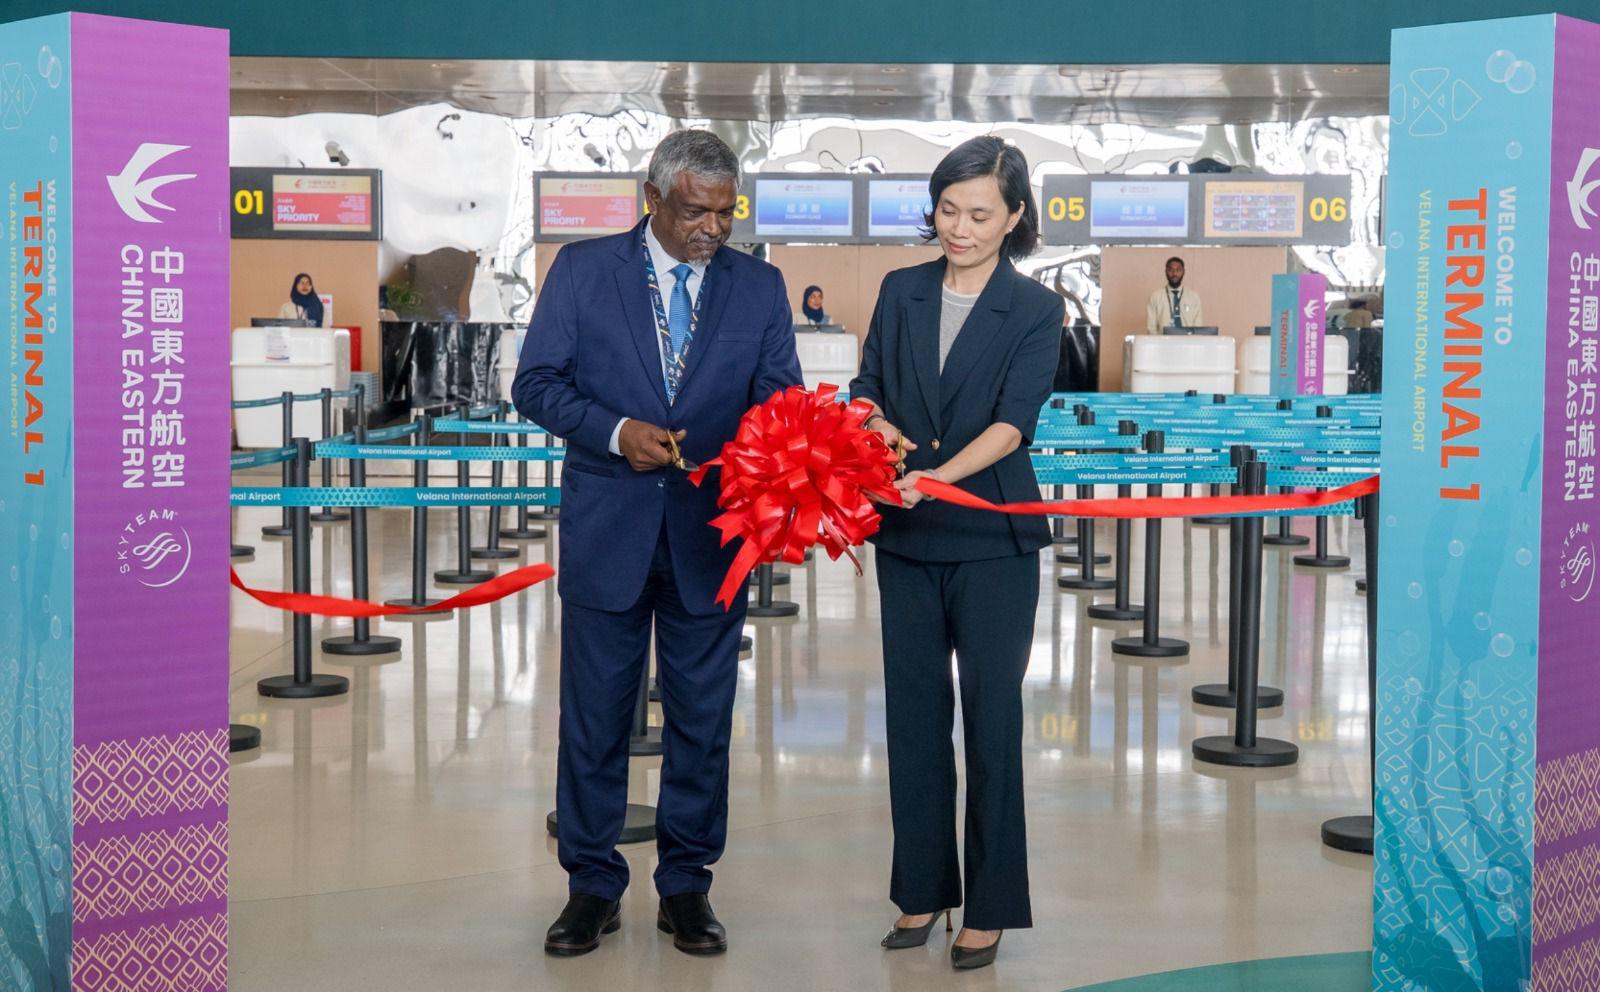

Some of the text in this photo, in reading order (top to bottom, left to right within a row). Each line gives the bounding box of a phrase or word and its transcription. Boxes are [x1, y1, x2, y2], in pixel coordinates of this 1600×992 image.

[234, 189, 264, 215] 01
[277, 205, 296, 213] SKY
[733, 195, 750, 220] 3
[1048, 196, 1086, 221] 05
[1309, 197, 1347, 222] 06
[277, 213, 320, 222] PRIORITY
[543, 217, 586, 225] PRIORITY
[47, 179, 57, 334] WELCOME TO
[1494, 186, 1517, 346] WELCOME TO
[9, 182, 18, 438] VELANA INTERNATIONAL AIRPORT
[1412, 190, 1432, 452] VELANA INTERNATIONAL AIRPORT
[24, 181, 44, 486] TERMINAL 1
[1439, 188, 1488, 501] TERMINAL 1
[121, 244, 145, 489] CHINA EASTERN
[149, 245, 187, 488] 中國東方航空
[1564, 251, 1581, 501] CHINA EASTERN
[1577, 252, 1600, 501] 中國東方航空
[357, 447, 452, 457] Velana International Airport
[1195, 454, 1219, 463] Airport
[1327, 456, 1373, 464] International
[1107, 472, 1158, 480] International
[1160, 472, 1187, 481] Airport
[249, 492, 281, 502] Airport
[416, 491, 546, 502] Velana International Airport
[117, 508, 175, 574] SKYTEAM
